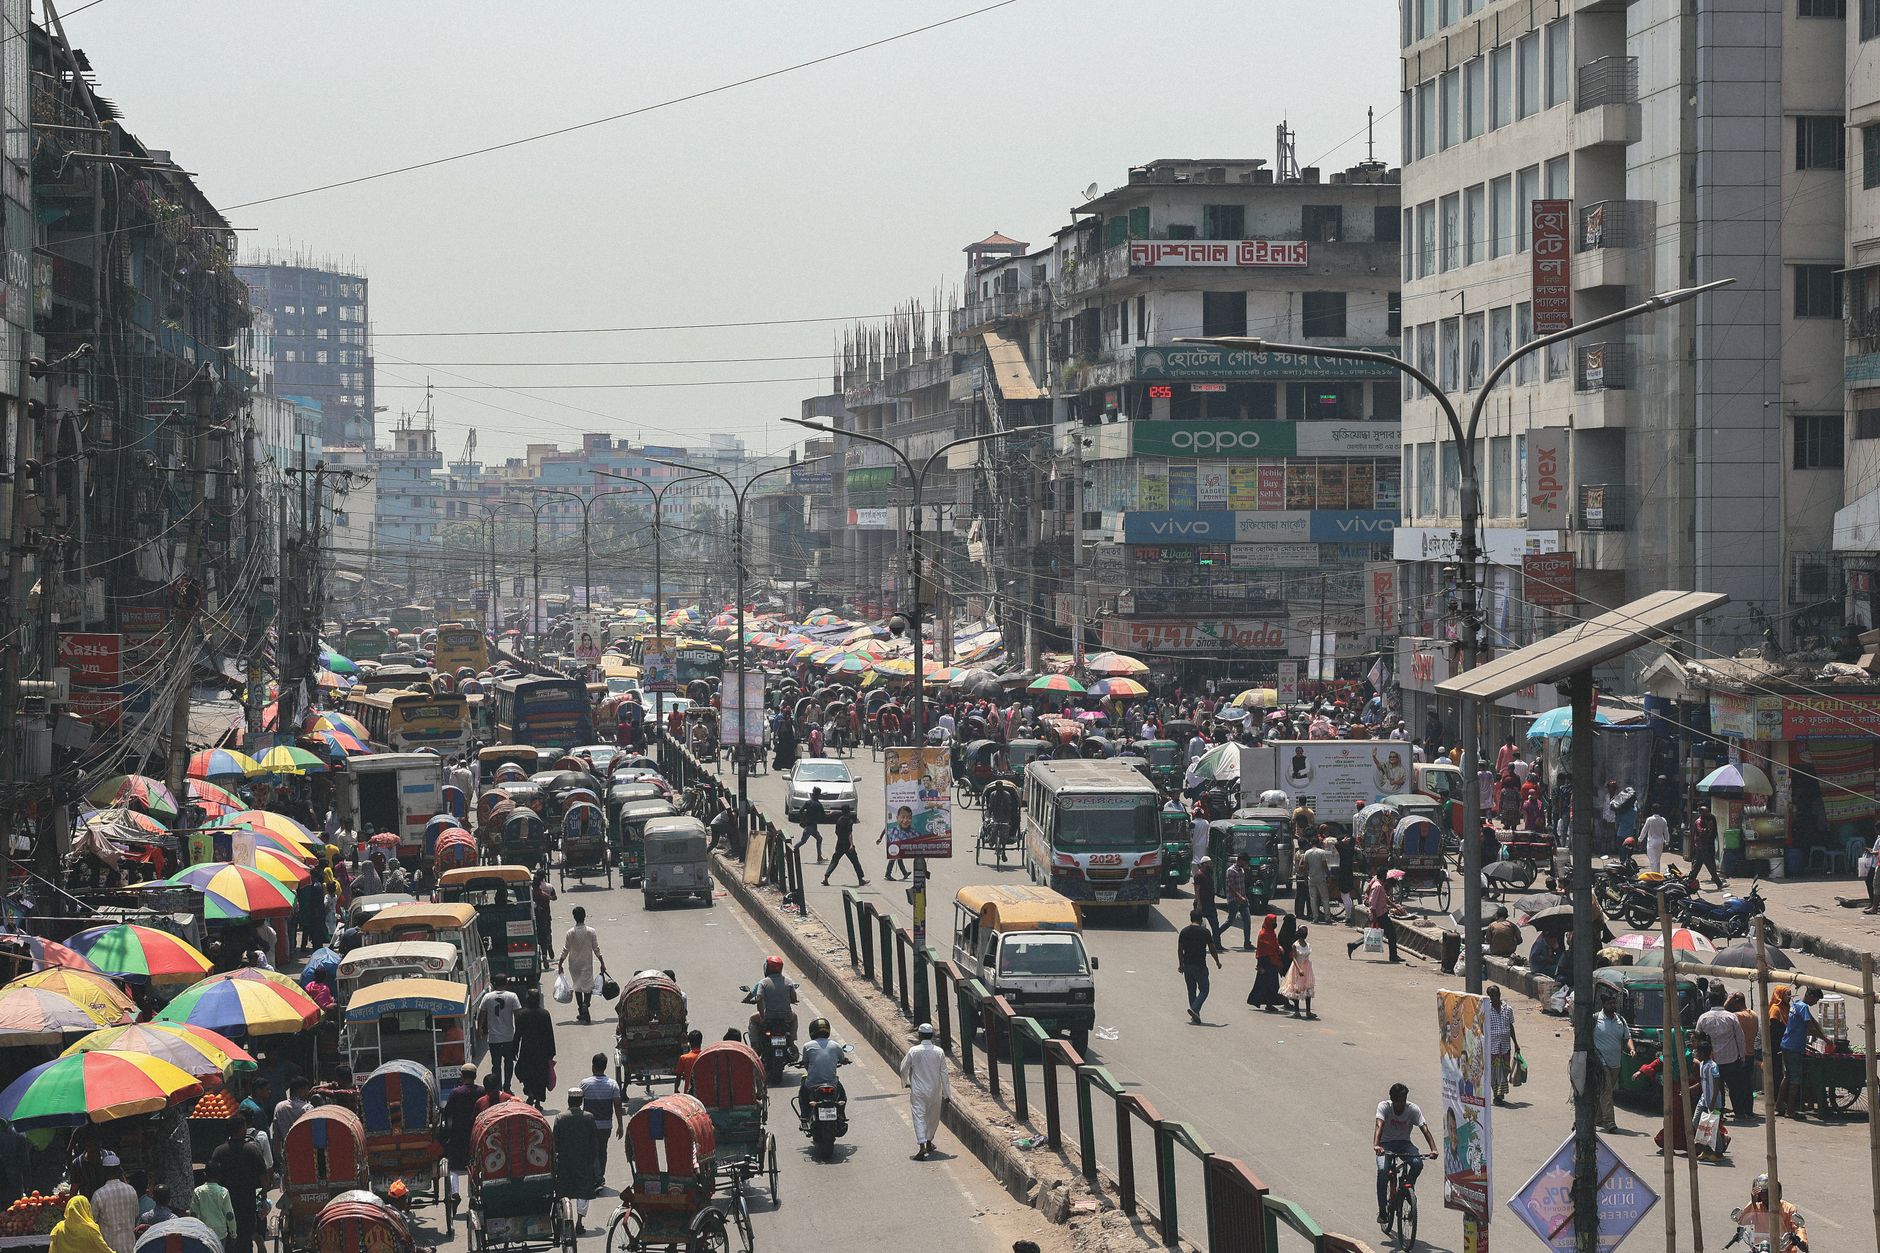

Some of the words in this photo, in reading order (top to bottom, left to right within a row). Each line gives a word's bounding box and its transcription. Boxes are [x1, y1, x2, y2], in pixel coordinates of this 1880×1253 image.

[1131, 244, 1229, 266] ন্যাশনাল
[1236, 240, 1307, 267] টেইলার্স
[1536, 285, 1568, 294] লন্ডন
[1535, 297, 1568, 308] প্যালেস
[1536, 309, 1569, 320] আবাসিক
[1167, 348, 1222, 368] হোটেল
[1149, 385, 1172, 398] 12:55
[1331, 428, 1371, 441] মুক্তিযোদ্ধা
[1373, 430, 1395, 441] সুপার
[1171, 430, 1260, 453] oppo
[1263, 480, 1279, 489] Buy
[1531, 447, 1563, 511] Apex
[1260, 490, 1274, 498] Sell
[1150, 517, 1210, 534] vivo
[1240, 519, 1278, 532] মুক্তিযোদ্ধা
[1280, 518, 1306, 529] মার্কেট
[1336, 515, 1395, 532] vivo
[1168, 547, 1193, 559] Dada
[1526, 559, 1571, 571] হোটেল
[1131, 621, 1198, 648] দাদা
[1222, 621, 1285, 648] Dada
[58, 636, 109, 657] Kazi's
[1089, 854, 1122, 865] 2023
